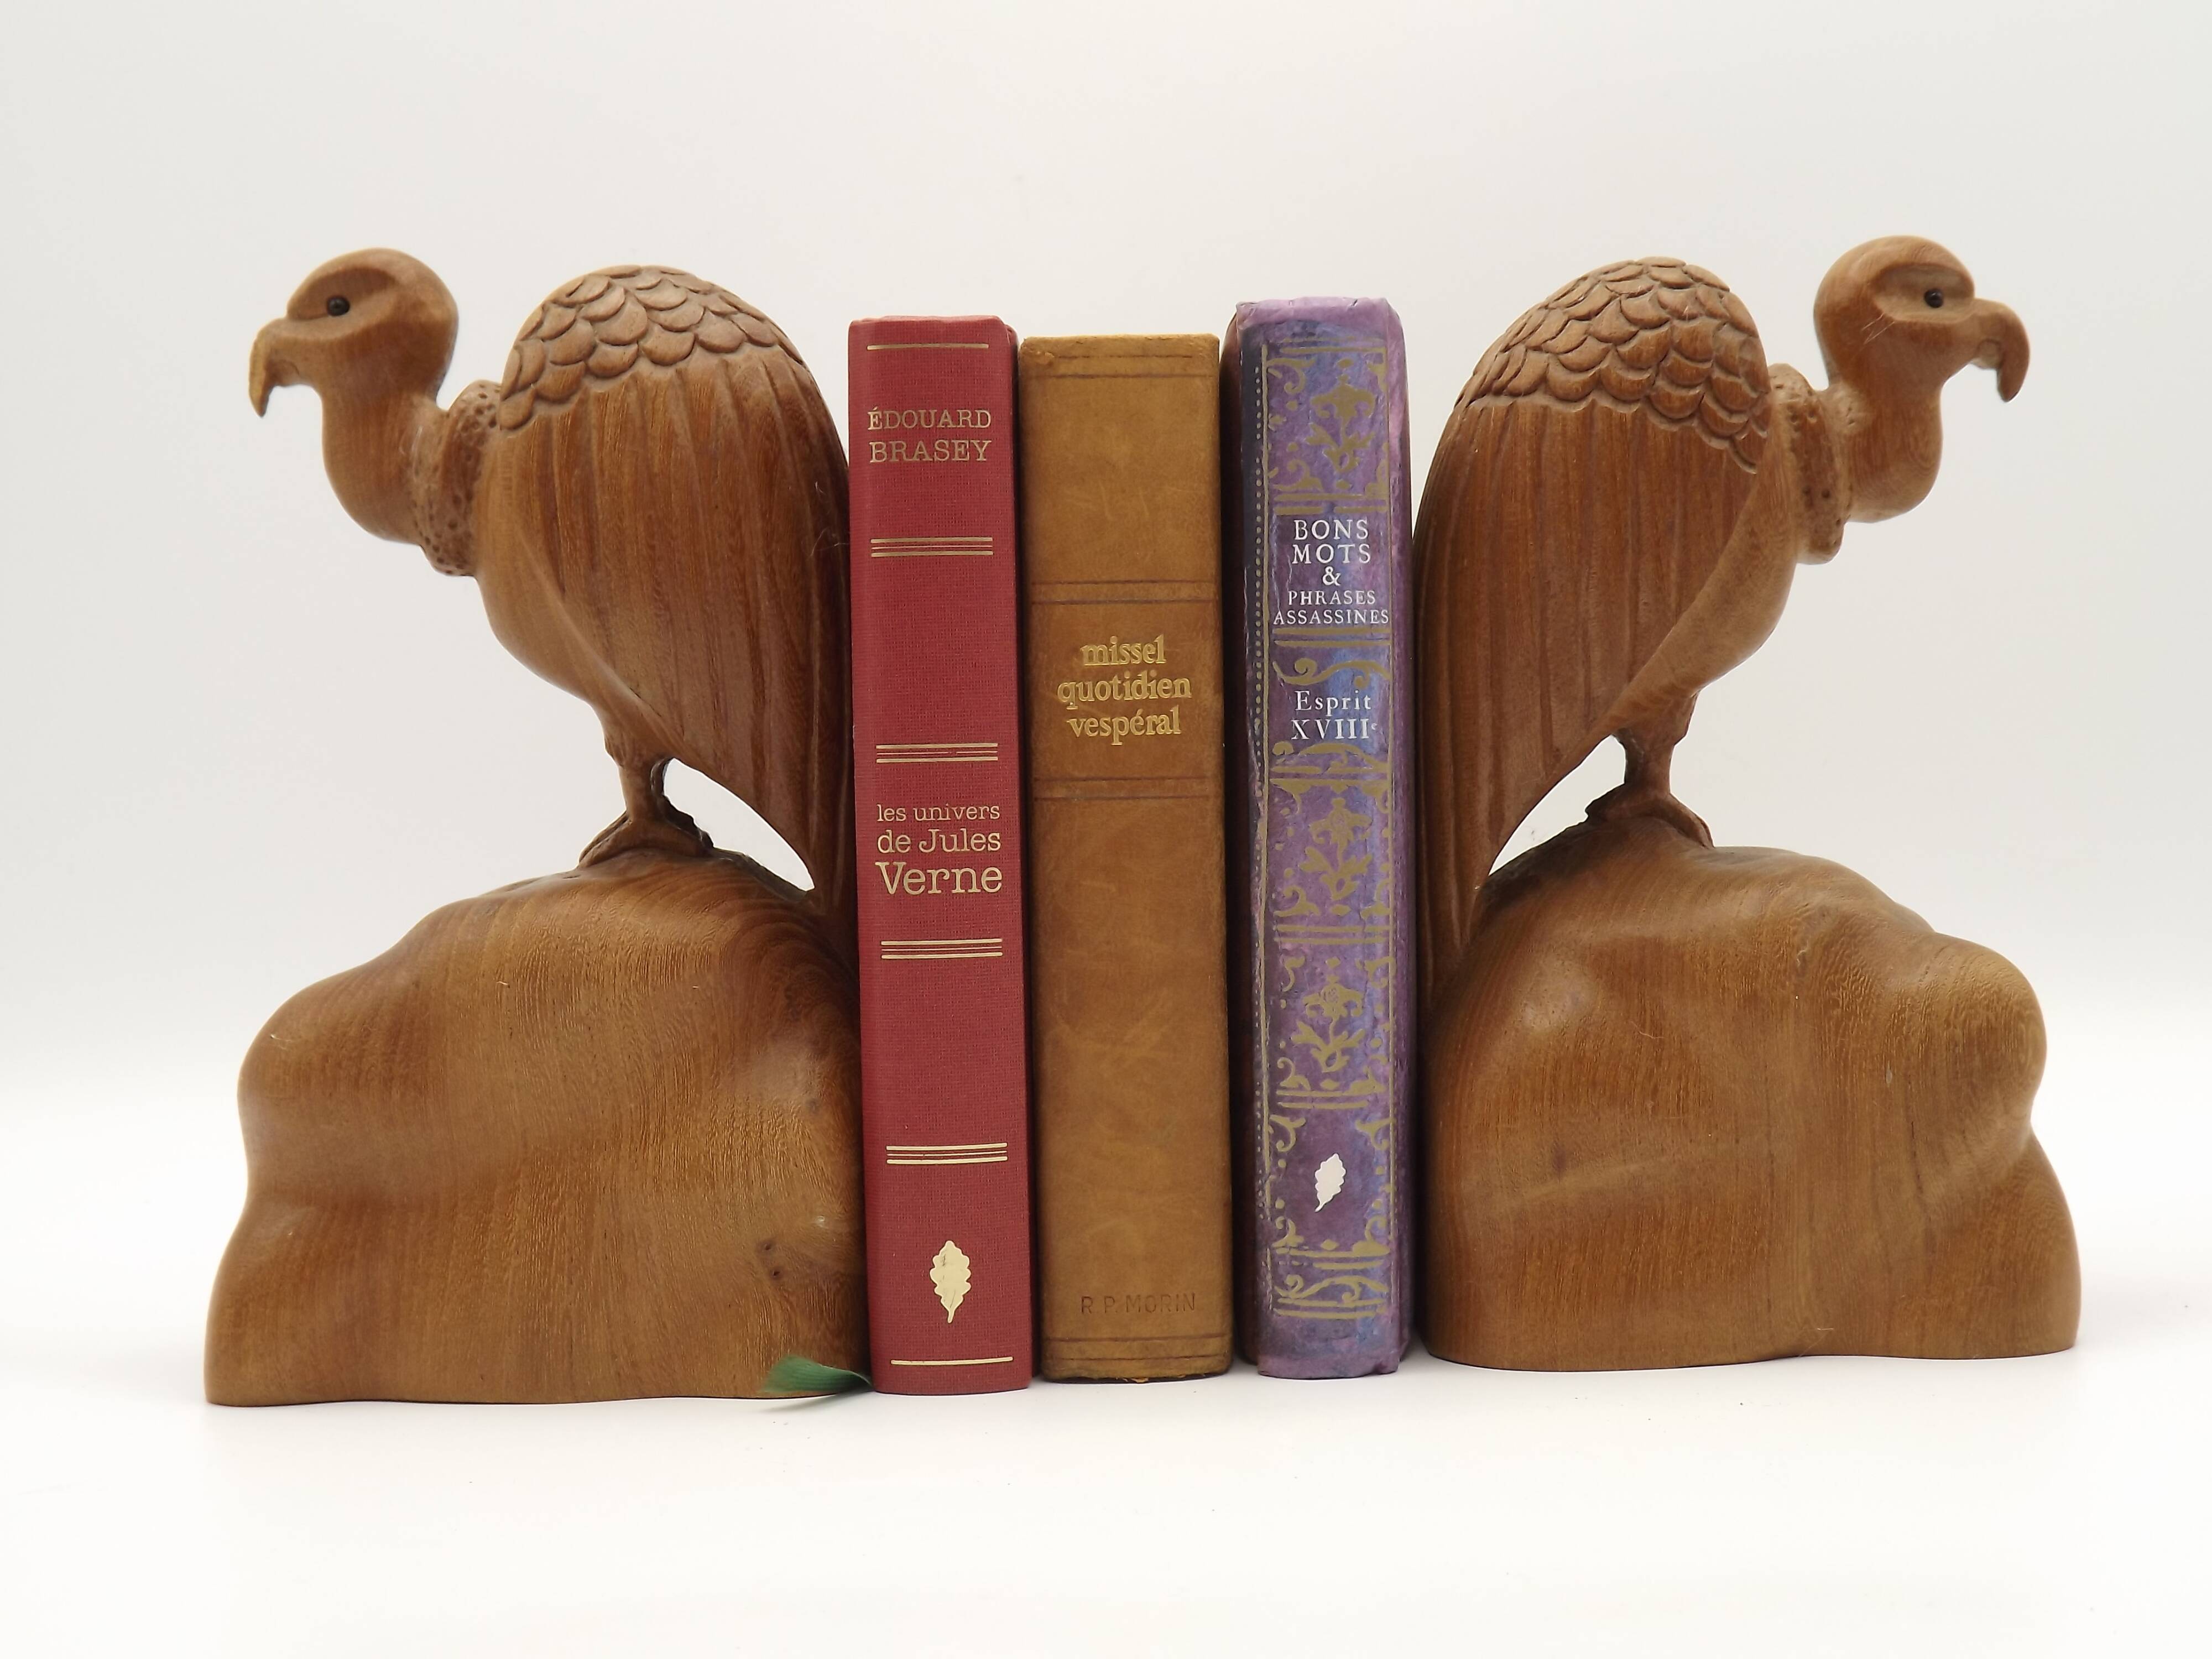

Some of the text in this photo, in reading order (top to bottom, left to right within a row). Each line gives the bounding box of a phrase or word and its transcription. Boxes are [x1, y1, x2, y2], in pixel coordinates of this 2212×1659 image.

[867, 406, 992, 430] ÉDOUARD
[869, 440, 992, 463] BRASEY
[1294, 519, 1369, 540] BONS
[1292, 544, 1371, 564] MOTS
[1322, 566, 1341, 586] &
[1288, 590, 1376, 606] PHRASES
[1273, 609, 1389, 625] ASSASSINES
[1080, 634, 1166, 666] missel
[1057, 670, 1192, 710] quotidien
[1295, 690, 1371, 717] Esprit
[1066, 705, 1181, 746] vespéral
[877, 803, 1000, 822] les univers
[877, 828, 1001, 853] de Jules
[875, 861, 1003, 895] Verne
[1126, 1292, 1195, 1313] MORIN
